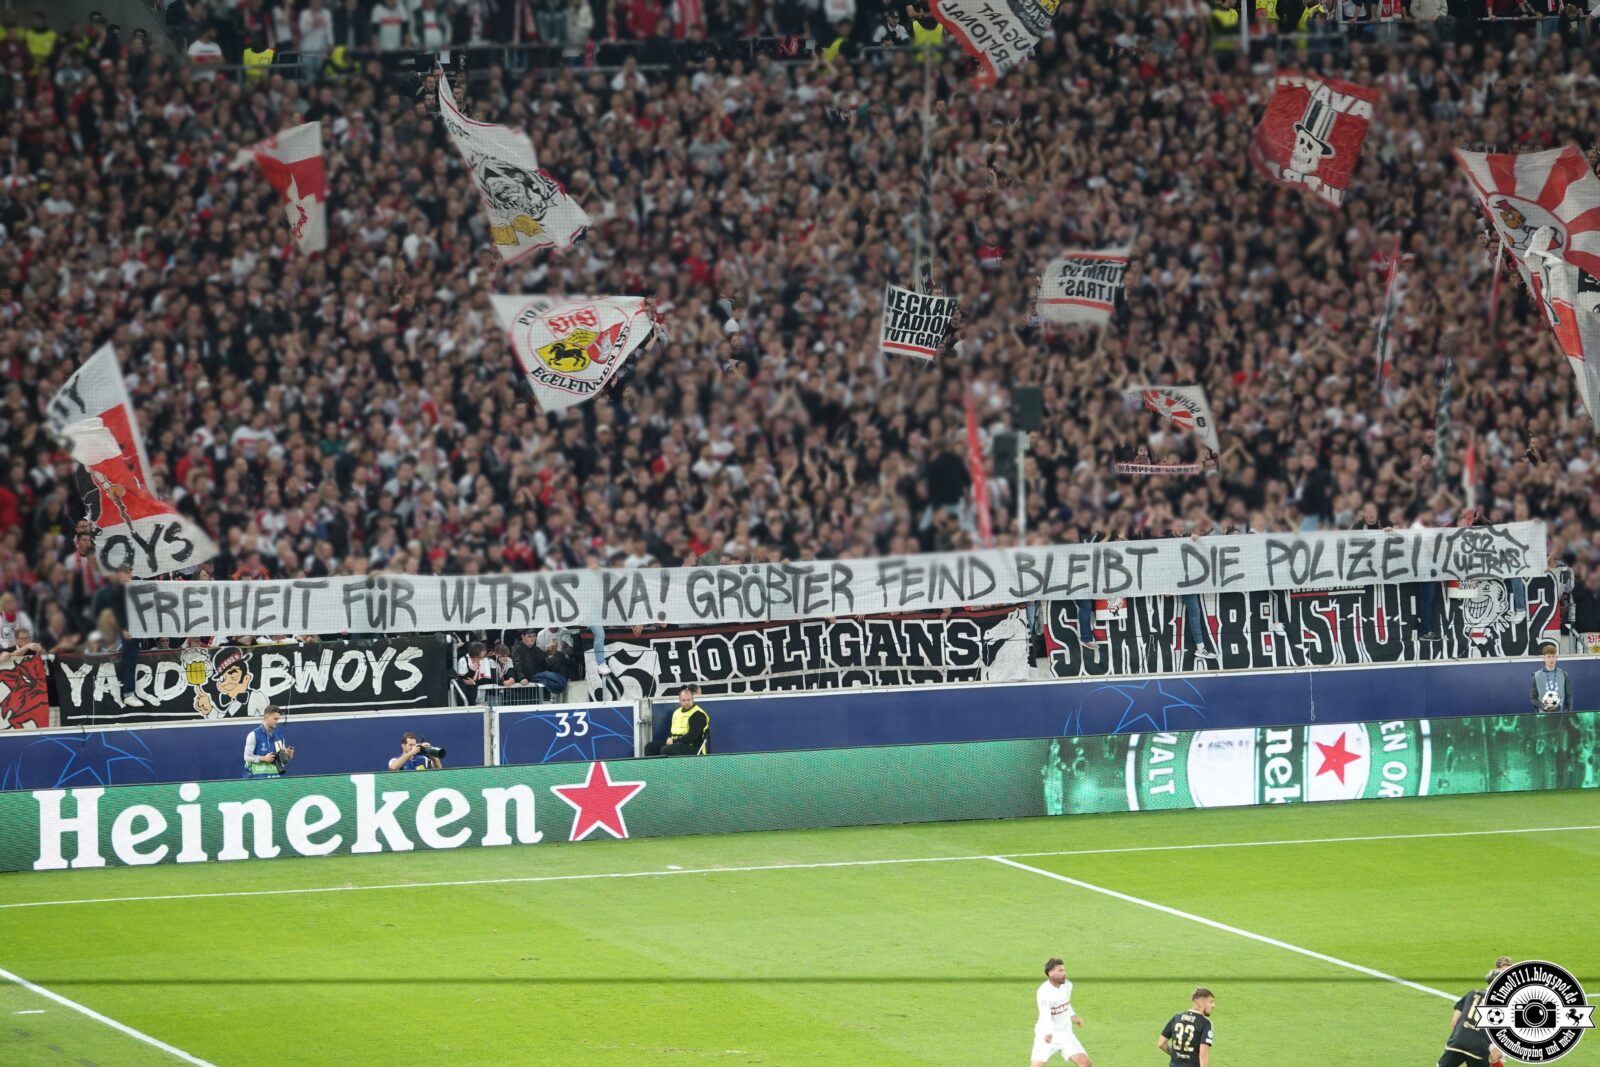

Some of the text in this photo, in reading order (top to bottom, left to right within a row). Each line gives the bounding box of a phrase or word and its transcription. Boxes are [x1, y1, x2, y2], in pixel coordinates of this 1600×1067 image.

[127, 581, 330, 633] FREIHEIT
[342, 576, 418, 632] FÜR
[440, 572, 579, 625] ULTRAS
[601, 569, 670, 622] KA!
[876, 556, 996, 606] FEIND
[1009, 544, 1158, 598] BLEIBT
[1177, 542, 1245, 588] DIE
[1266, 533, 1443, 586] POLIZEI!
[1453, 547, 1520, 576] ULTRAS
[60, 647, 424, 709] YARD BWOYS
[654, 619, 983, 684] HOOLIGANS
[555, 711, 589, 738] 33
[32, 774, 543, 871] Heineken
[1173, 1022, 1195, 1052] 32
